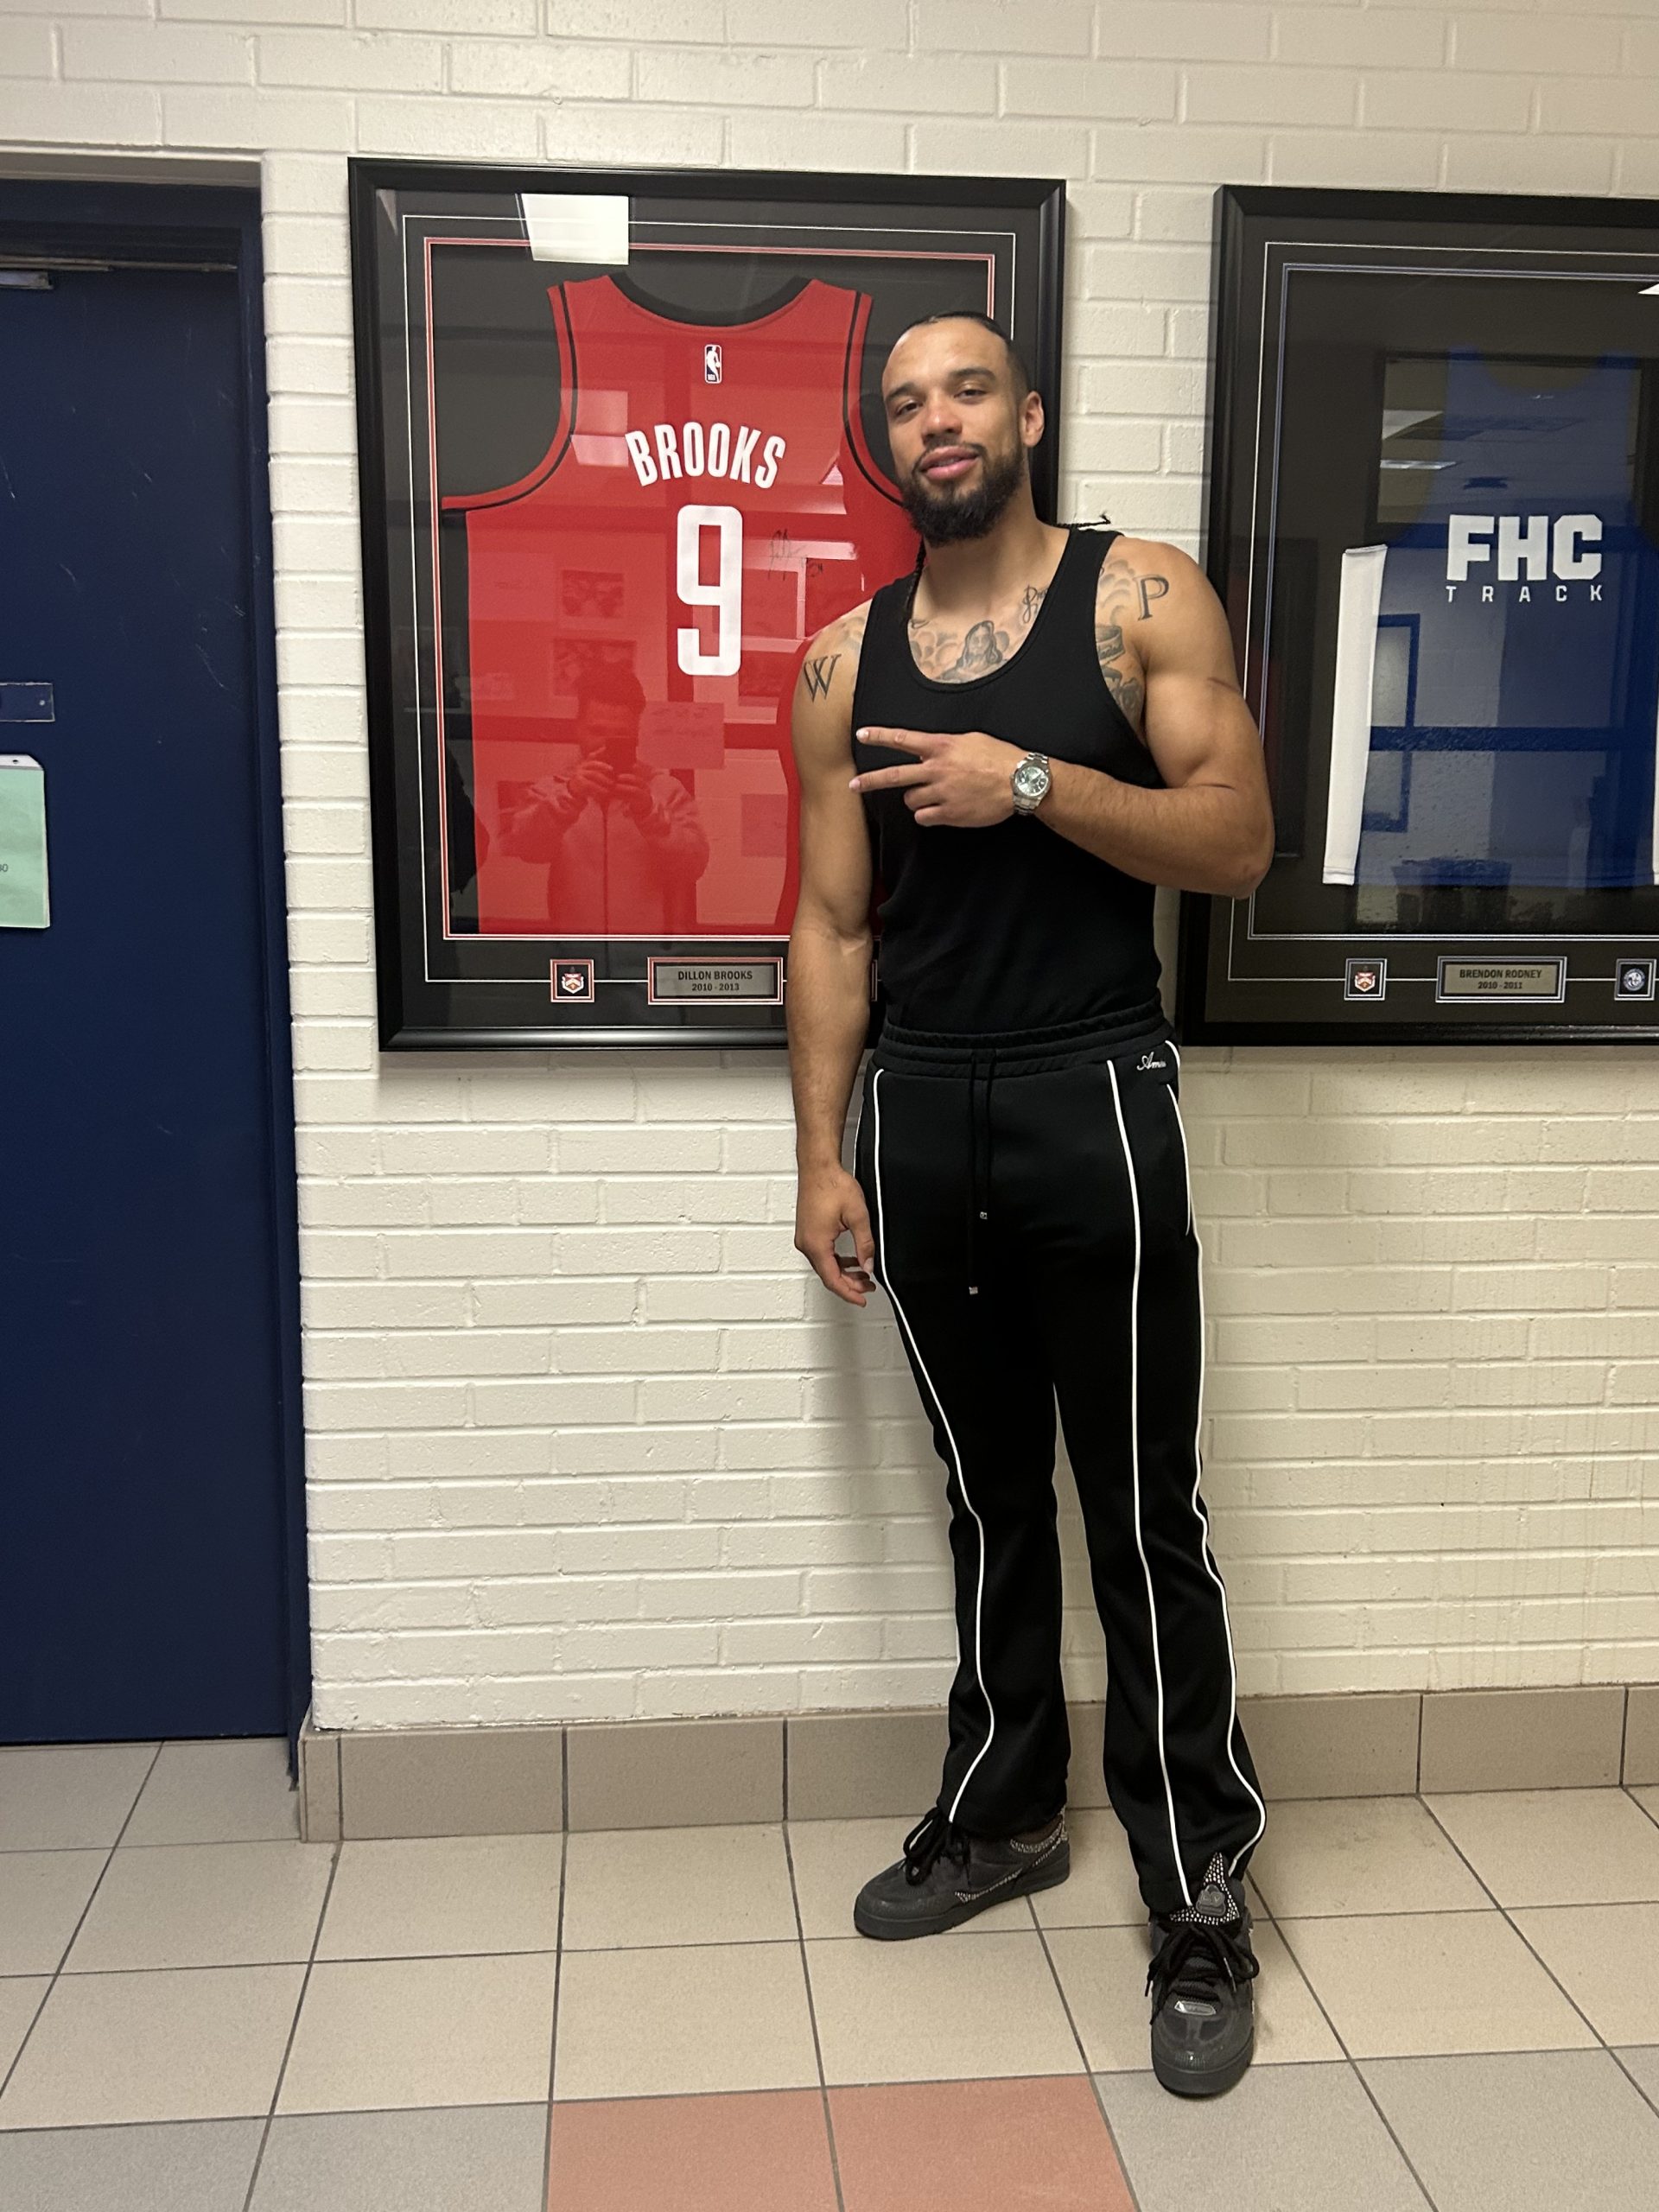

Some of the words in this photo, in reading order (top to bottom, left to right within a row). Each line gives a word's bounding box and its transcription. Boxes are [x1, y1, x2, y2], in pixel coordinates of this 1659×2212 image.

[625, 422, 786, 489] BROOKS
[1446, 514, 1603, 581] FHC
[677, 505, 743, 677] 9
[1133, 574, 1170, 621] P
[1446, 585, 1603, 602] TRACK
[803, 653, 842, 702] W
[678, 970, 712, 980] DILLON
[714, 970, 753, 980] BROOKS
[1459, 969, 1503, 978] BRENDON
[1505, 969, 1542, 978] RODNEY
